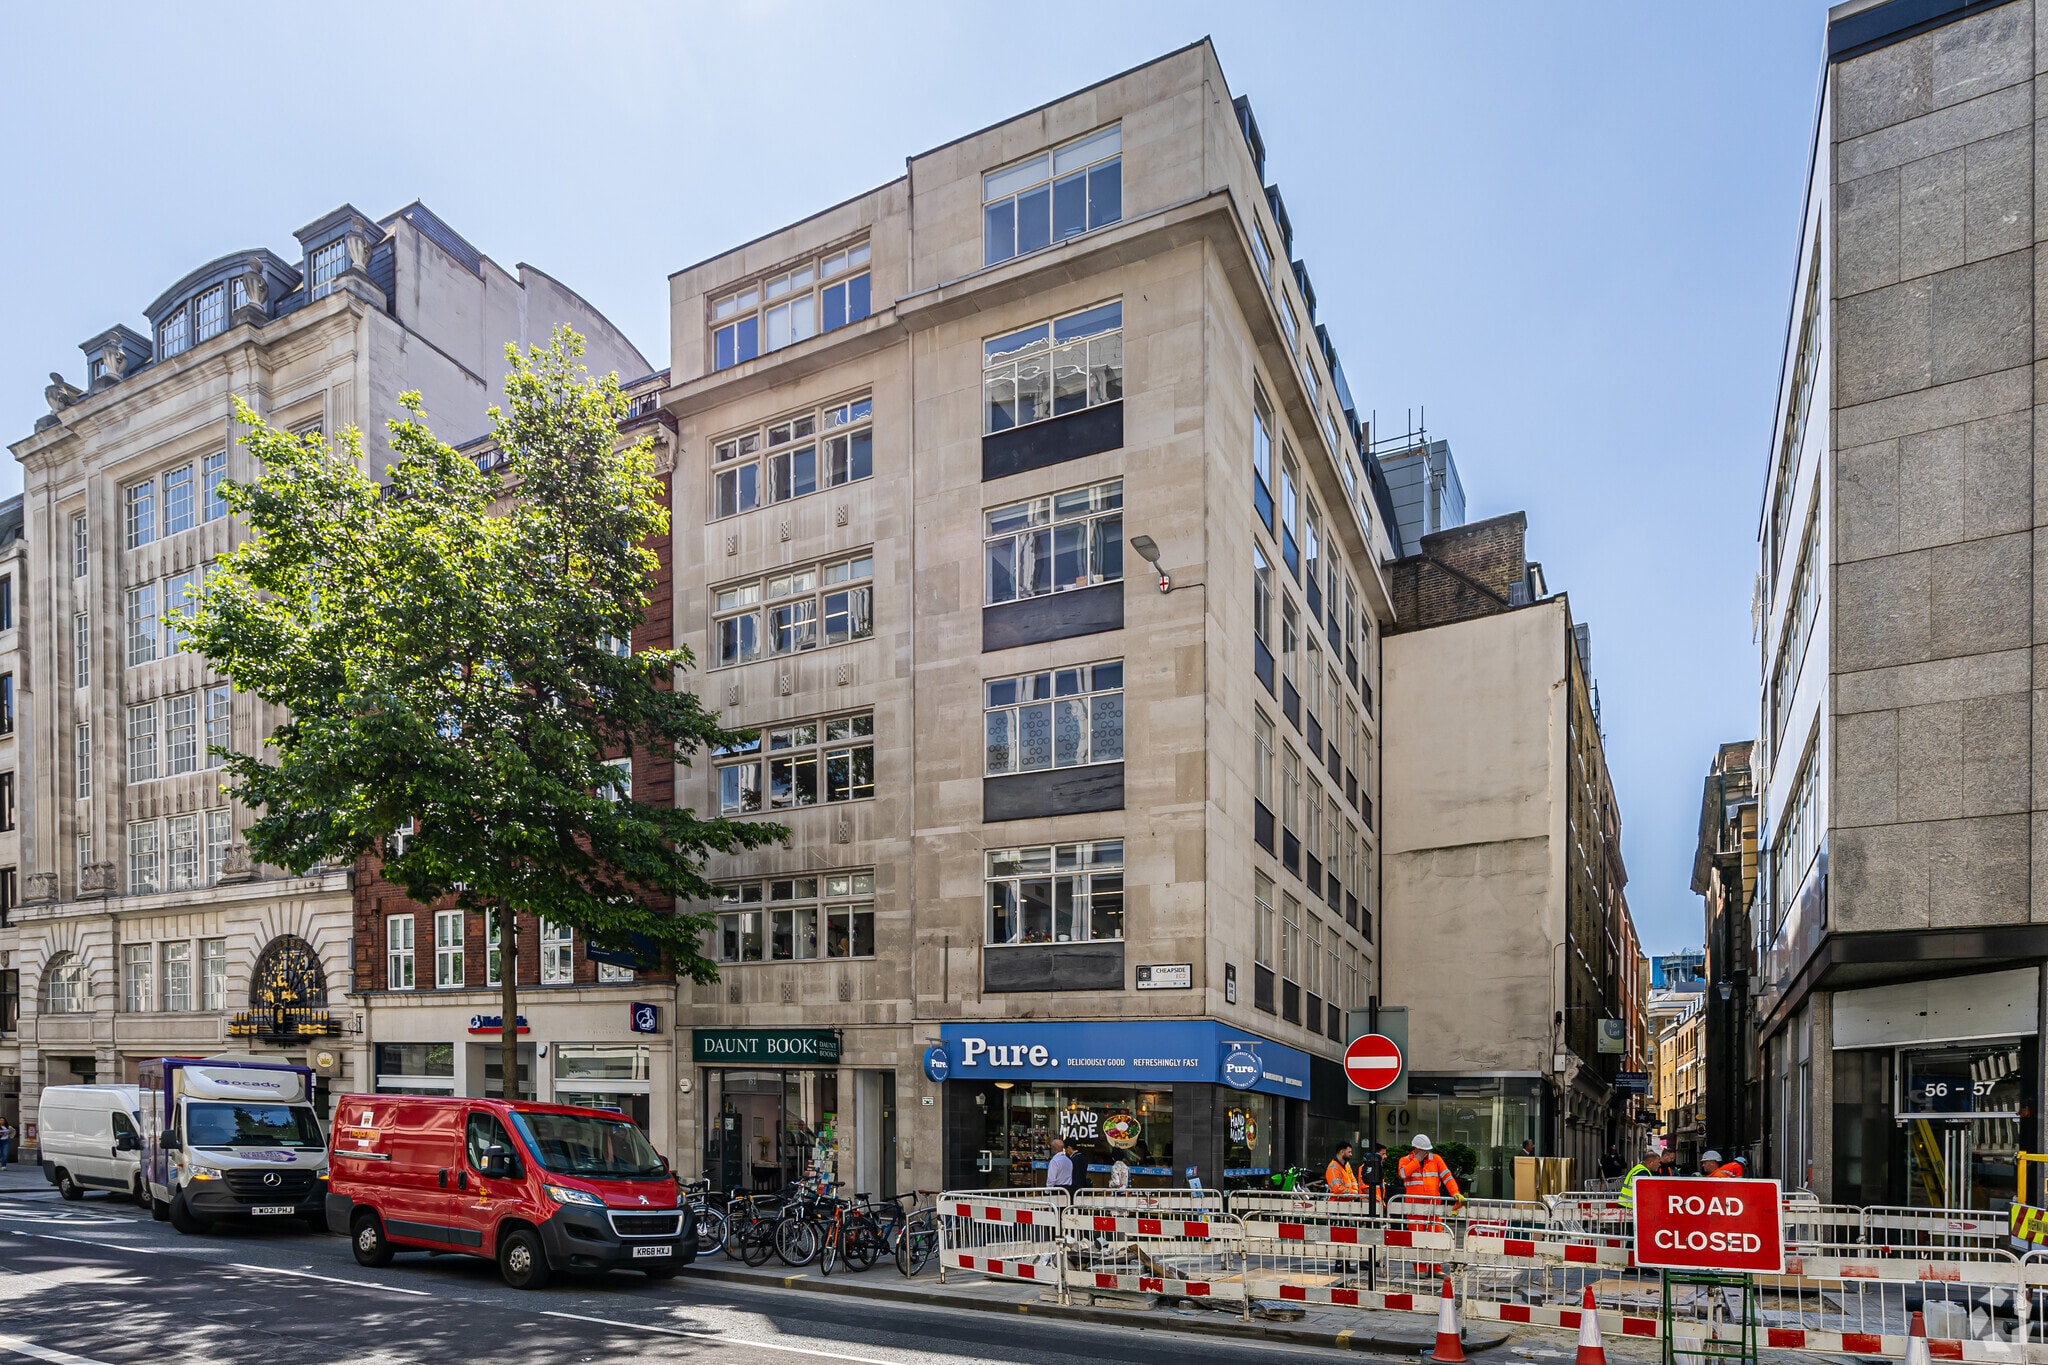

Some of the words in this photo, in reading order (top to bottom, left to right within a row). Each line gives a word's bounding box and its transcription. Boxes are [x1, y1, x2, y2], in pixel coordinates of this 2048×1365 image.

[1609, 1020, 1618, 1028] To
[1609, 1028, 1620, 1036] Let
[704, 1038, 759, 1053] DAUNT
[819, 1041, 837, 1049] DAUNT
[819, 1050, 837, 1058] BOOKS
[961, 1037, 1059, 1067] Pure.
[931, 1058, 948, 1069] Pure.
[1067, 1057, 1106, 1067] DELICIOUSLY
[1107, 1058, 1126, 1067] GOOD
[1133, 1058, 1181, 1067] REFRESHINGLY
[1182, 1058, 1199, 1067] FAST
[1226, 1063, 1257, 1073] Pure.
[231, 1080, 281, 1088] ocado
[1925, 1083, 1948, 1097] 56
[1973, 1081, 1996, 1096] 57
[1060, 1110, 1099, 1126] HAND
[1230, 1113, 1245, 1128] HAND
[1387, 1109, 1410, 1126] 60
[1059, 1123, 1099, 1141] MADE
[1230, 1126, 1245, 1143] MADE
[1667, 1195, 1744, 1217] ROAD
[1654, 1229, 1762, 1253] CLOSED
[636, 1248, 656, 1256] KR68
[656, 1247, 670, 1255] HXJ
